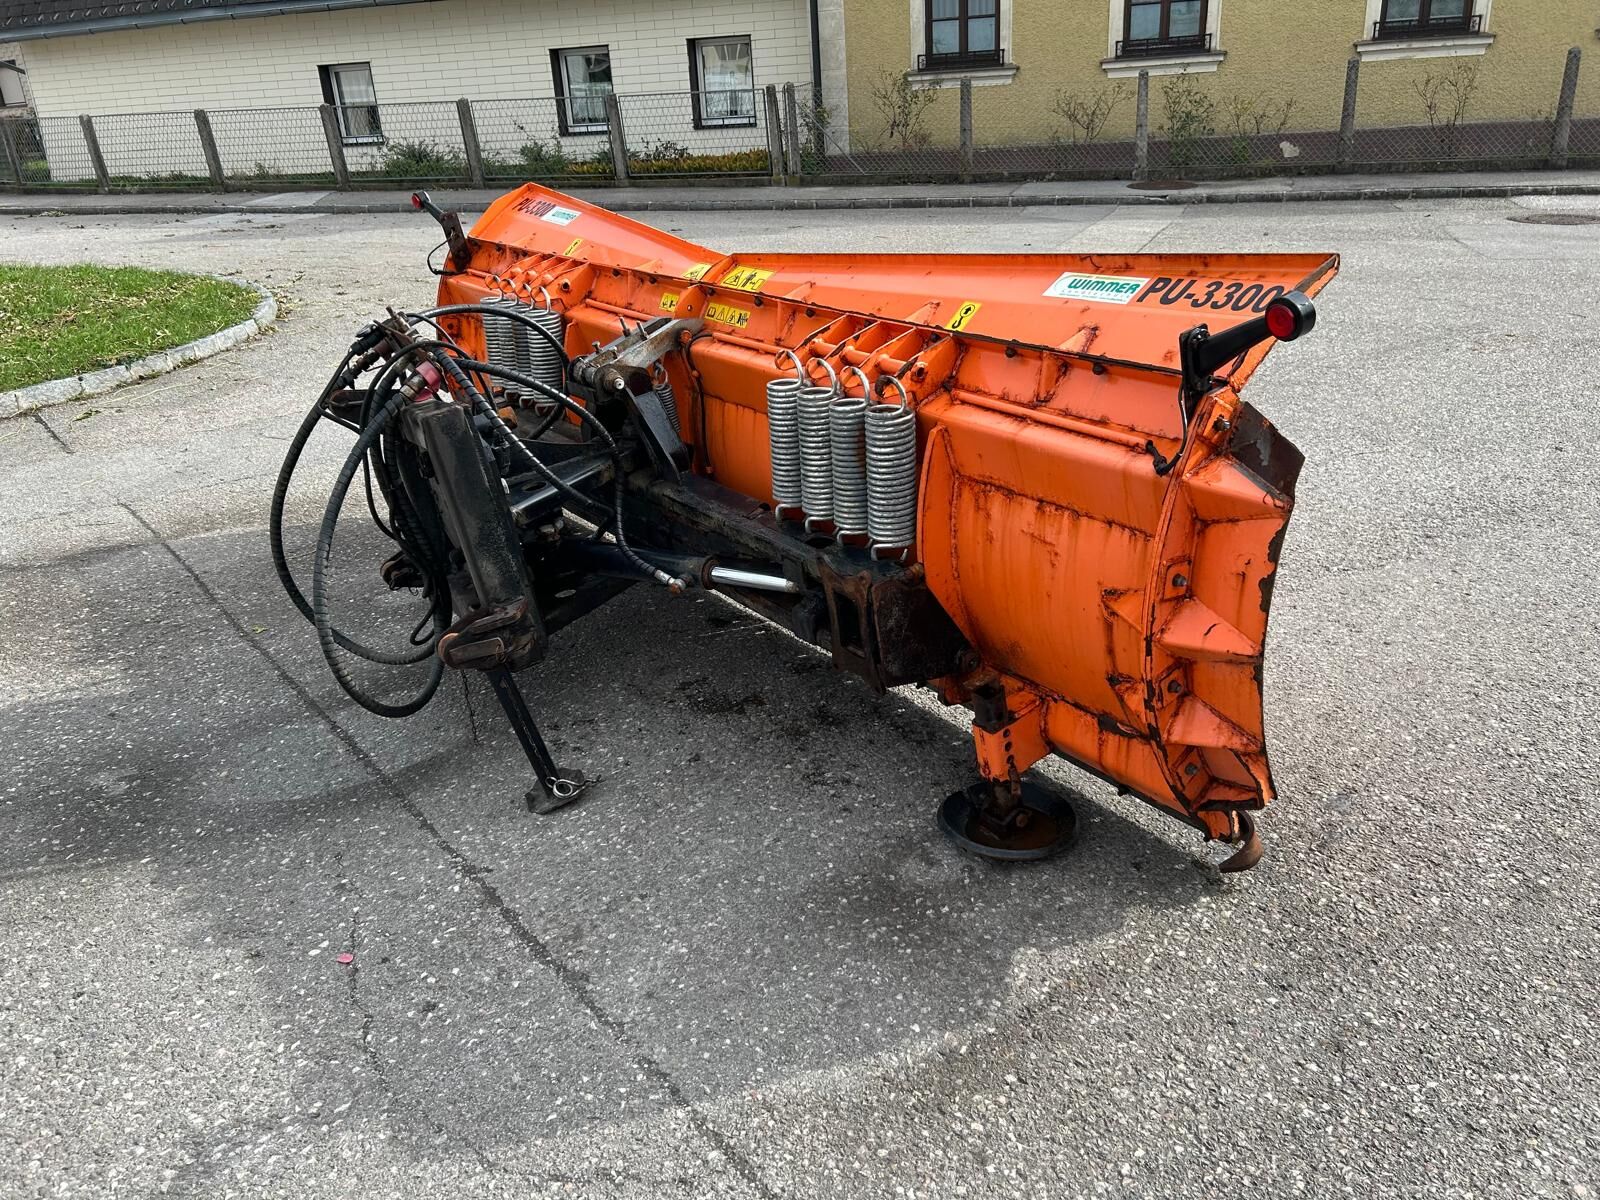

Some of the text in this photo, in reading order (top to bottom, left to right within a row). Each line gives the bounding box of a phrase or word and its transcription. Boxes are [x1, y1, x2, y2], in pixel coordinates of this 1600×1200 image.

[512, 197, 557, 218] PU-3300
[1067, 278, 1141, 294] WIMMER
[1136, 276, 1285, 314] PU-3300
